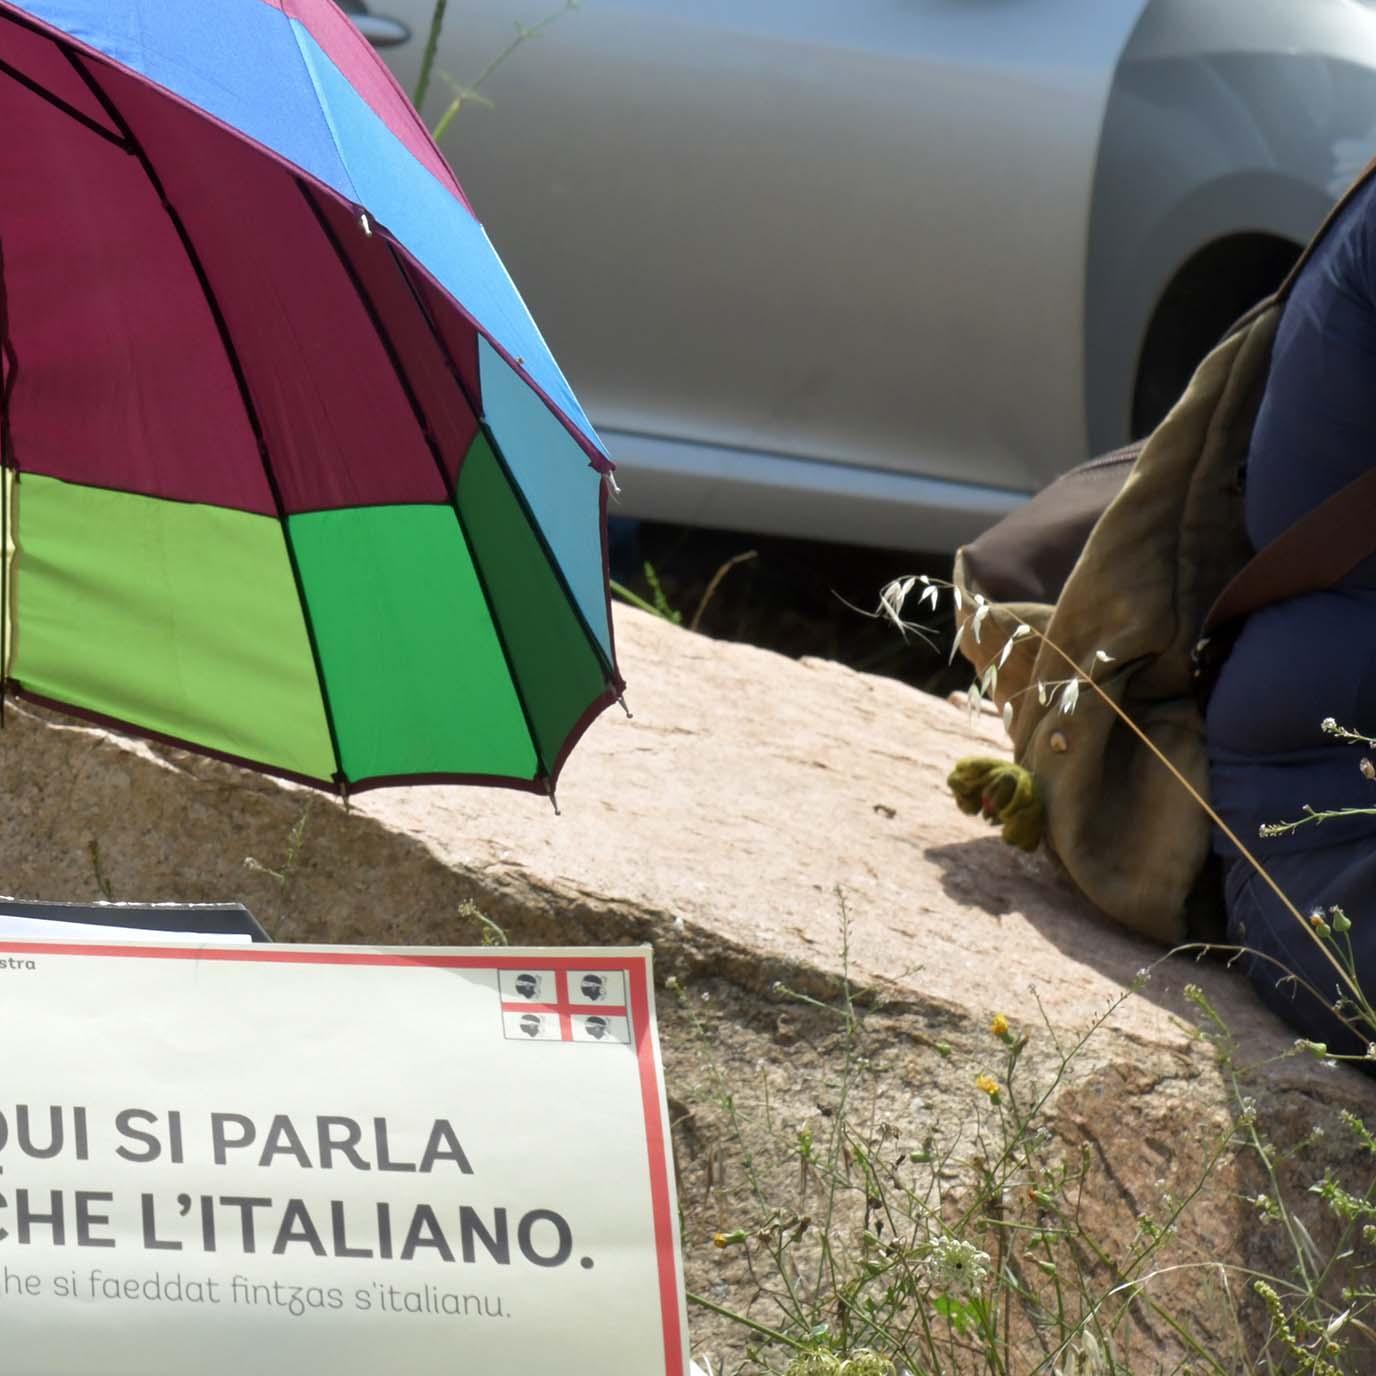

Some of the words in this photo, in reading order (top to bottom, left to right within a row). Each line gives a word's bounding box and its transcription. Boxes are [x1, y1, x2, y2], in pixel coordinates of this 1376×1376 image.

[115, 1108, 185, 1165] SI
[210, 1112, 476, 1176] PARLA
[140, 1192, 595, 1270] L’ITALIANO.
[53, 1269, 79, 1298] si
[88, 1268, 222, 1304] faeddat
[354, 1280, 512, 1319] s'italianu.
